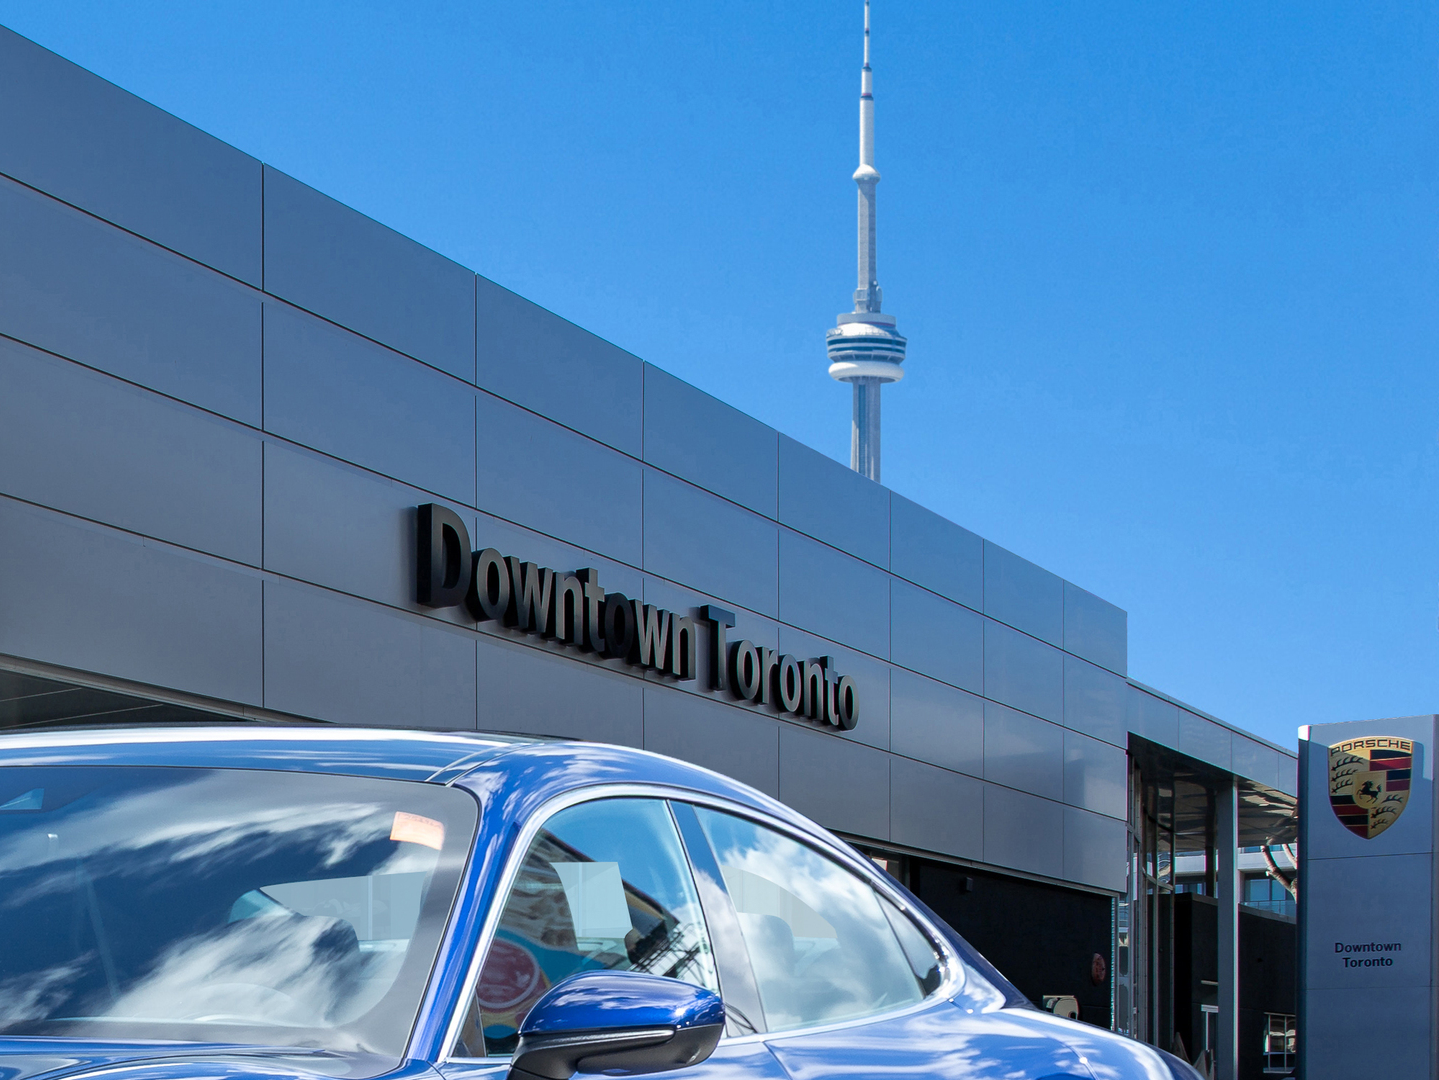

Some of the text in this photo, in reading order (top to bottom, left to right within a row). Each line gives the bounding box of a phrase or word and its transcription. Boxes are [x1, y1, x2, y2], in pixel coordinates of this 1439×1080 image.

[417, 503, 860, 731] Downtown Toronto
[1330, 739, 1411, 757] PORSCHE
[1334, 942, 1402, 953] Downtown
[1342, 957, 1393, 968] Toronto
